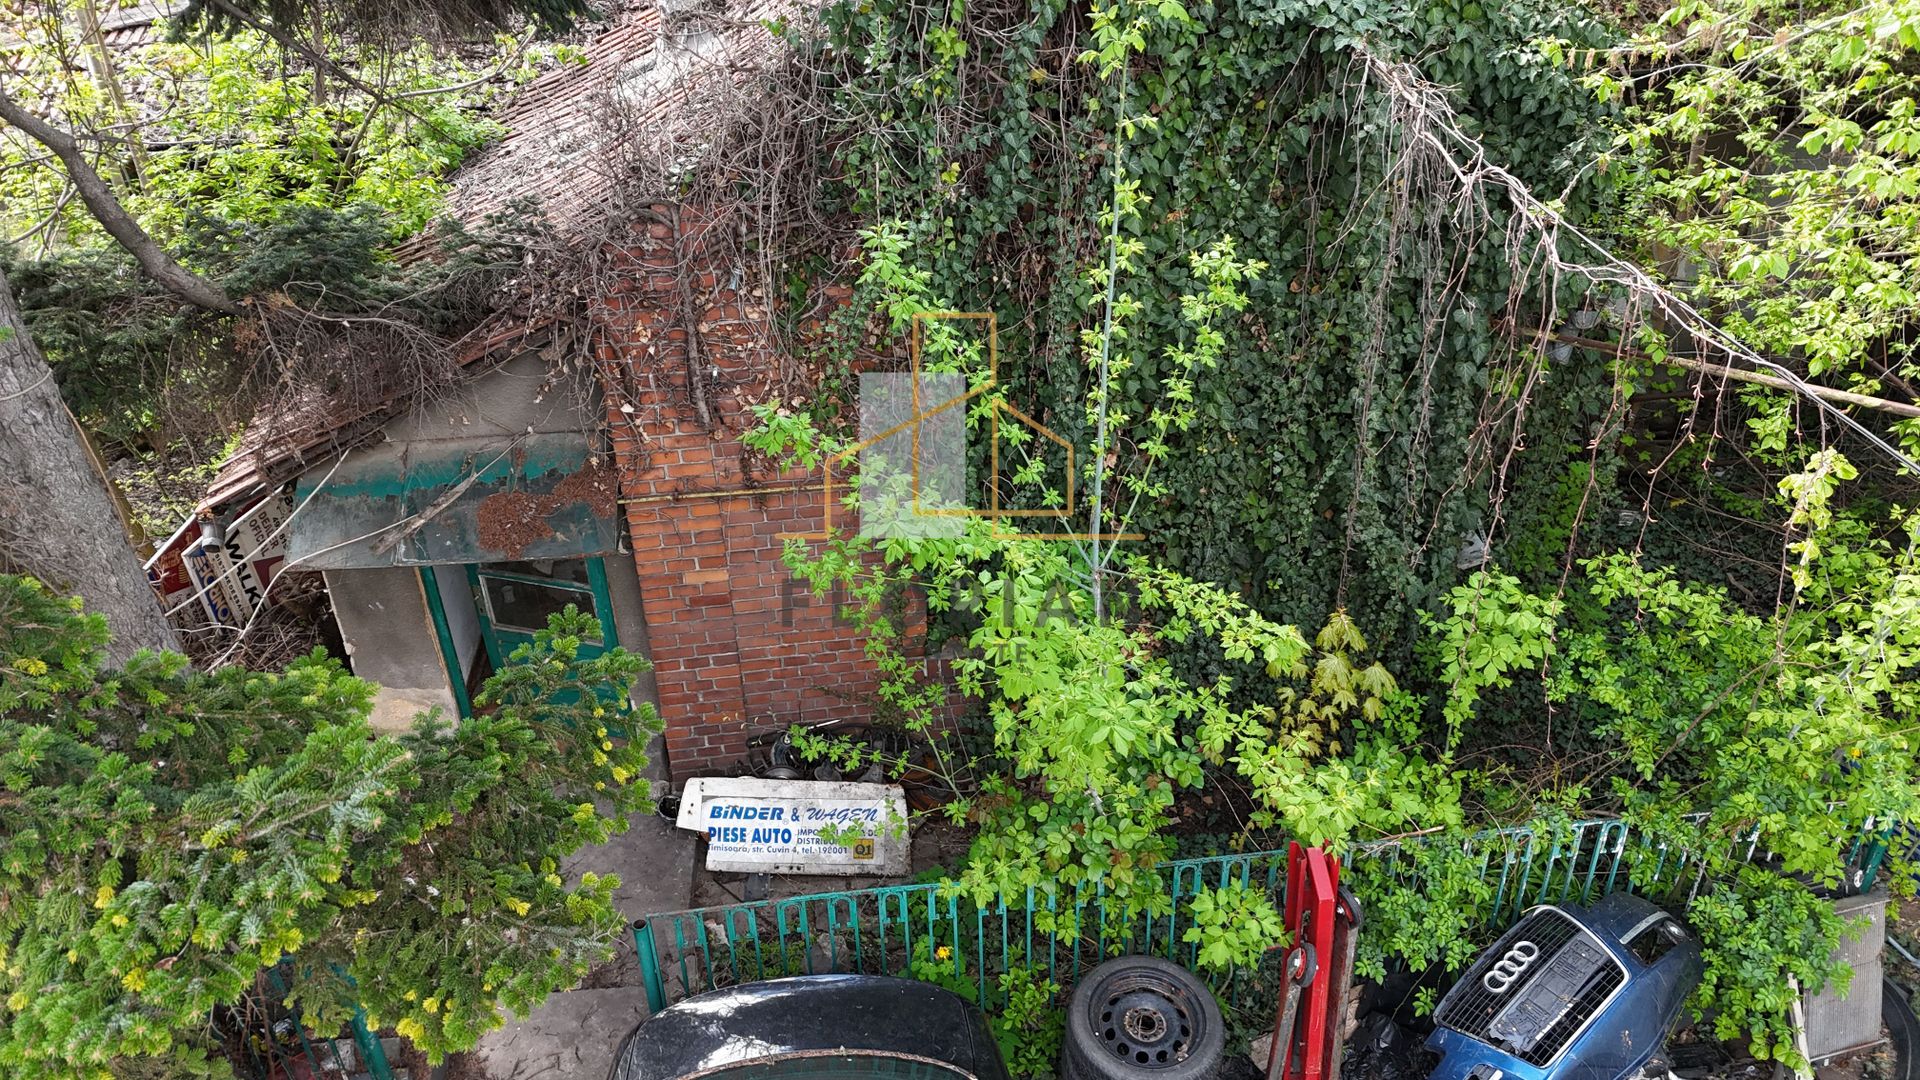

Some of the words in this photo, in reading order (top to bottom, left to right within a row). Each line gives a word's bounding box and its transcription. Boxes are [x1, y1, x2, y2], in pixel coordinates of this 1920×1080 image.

[791, 807, 800, 822] &
[807, 807, 878, 825] WAGEN
[708, 826, 747, 843] PIESE
[751, 826, 792, 844] AUTO
[752, 845, 764, 853] str.
[767, 846, 790, 854] Cuvin
[802, 846, 814, 854] tel.
[855, 844, 873, 856] Q1
